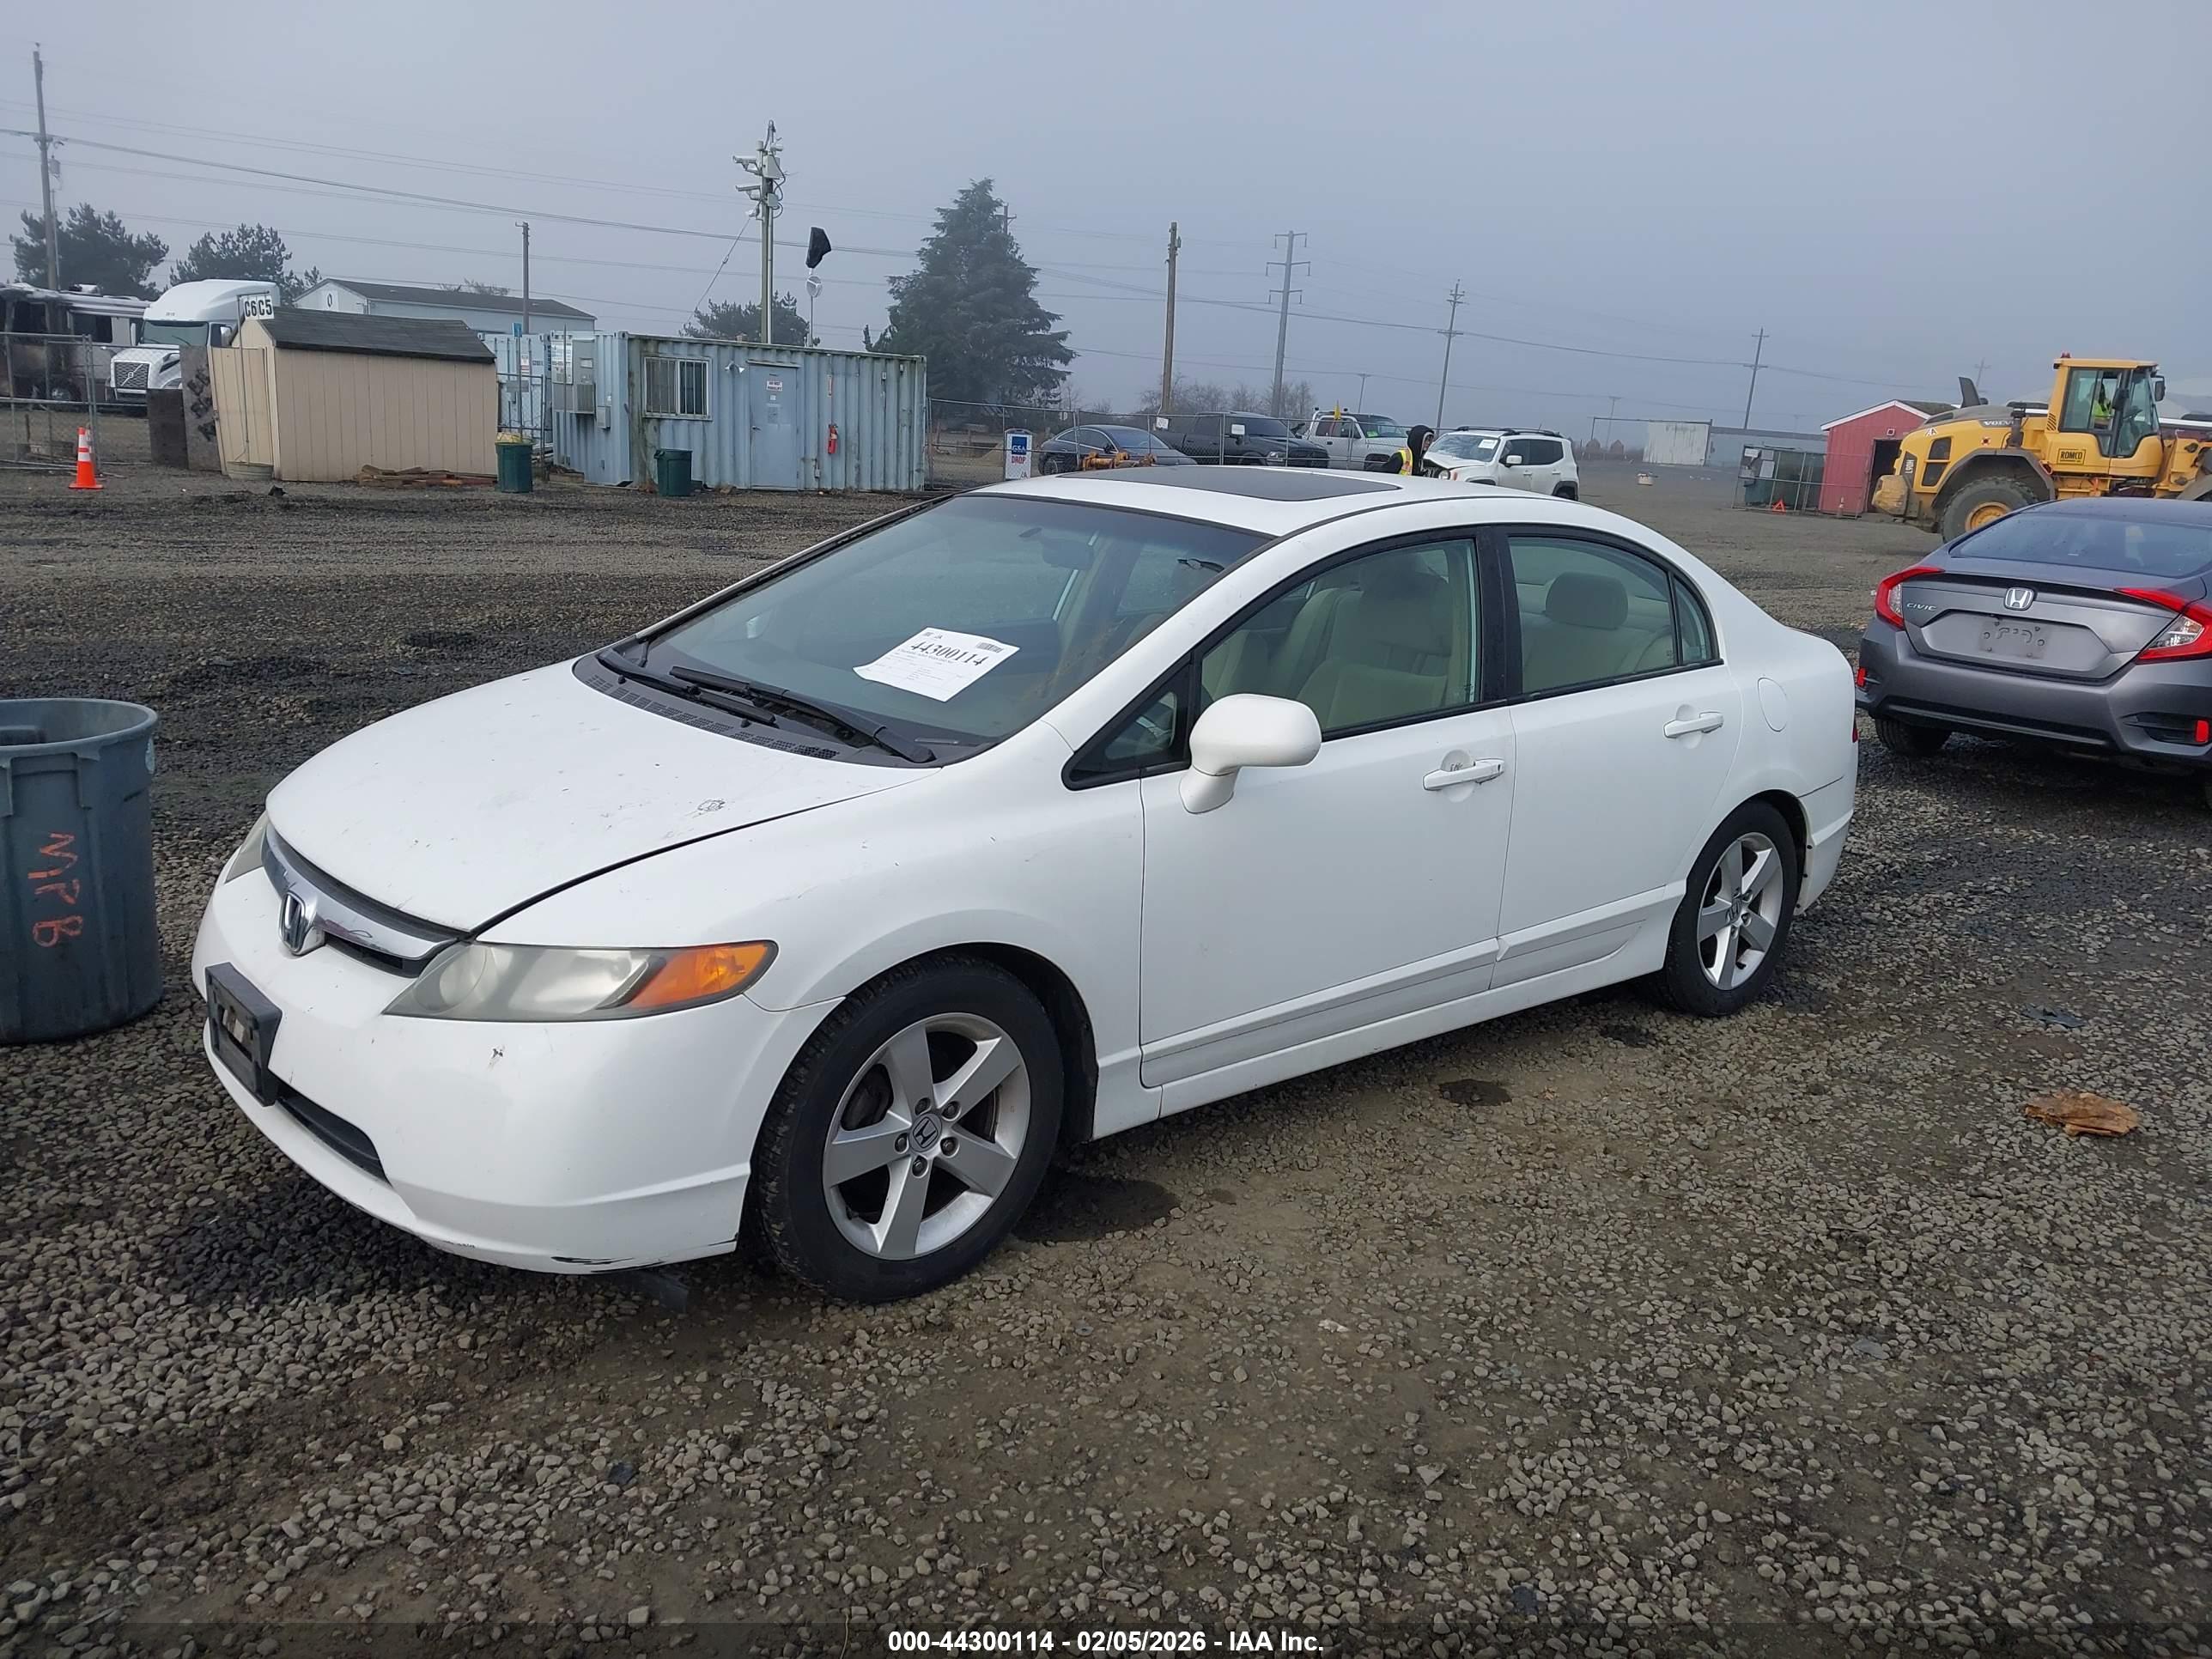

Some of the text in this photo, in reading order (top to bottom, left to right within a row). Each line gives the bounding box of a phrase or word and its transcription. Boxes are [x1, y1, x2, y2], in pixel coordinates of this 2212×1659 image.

[2060, 451, 2083, 459] ROMCO
[1011, 455, 1026, 465] DROP
[1906, 603, 1937, 611] CIVIC
[910, 641, 989, 666] 44300114
